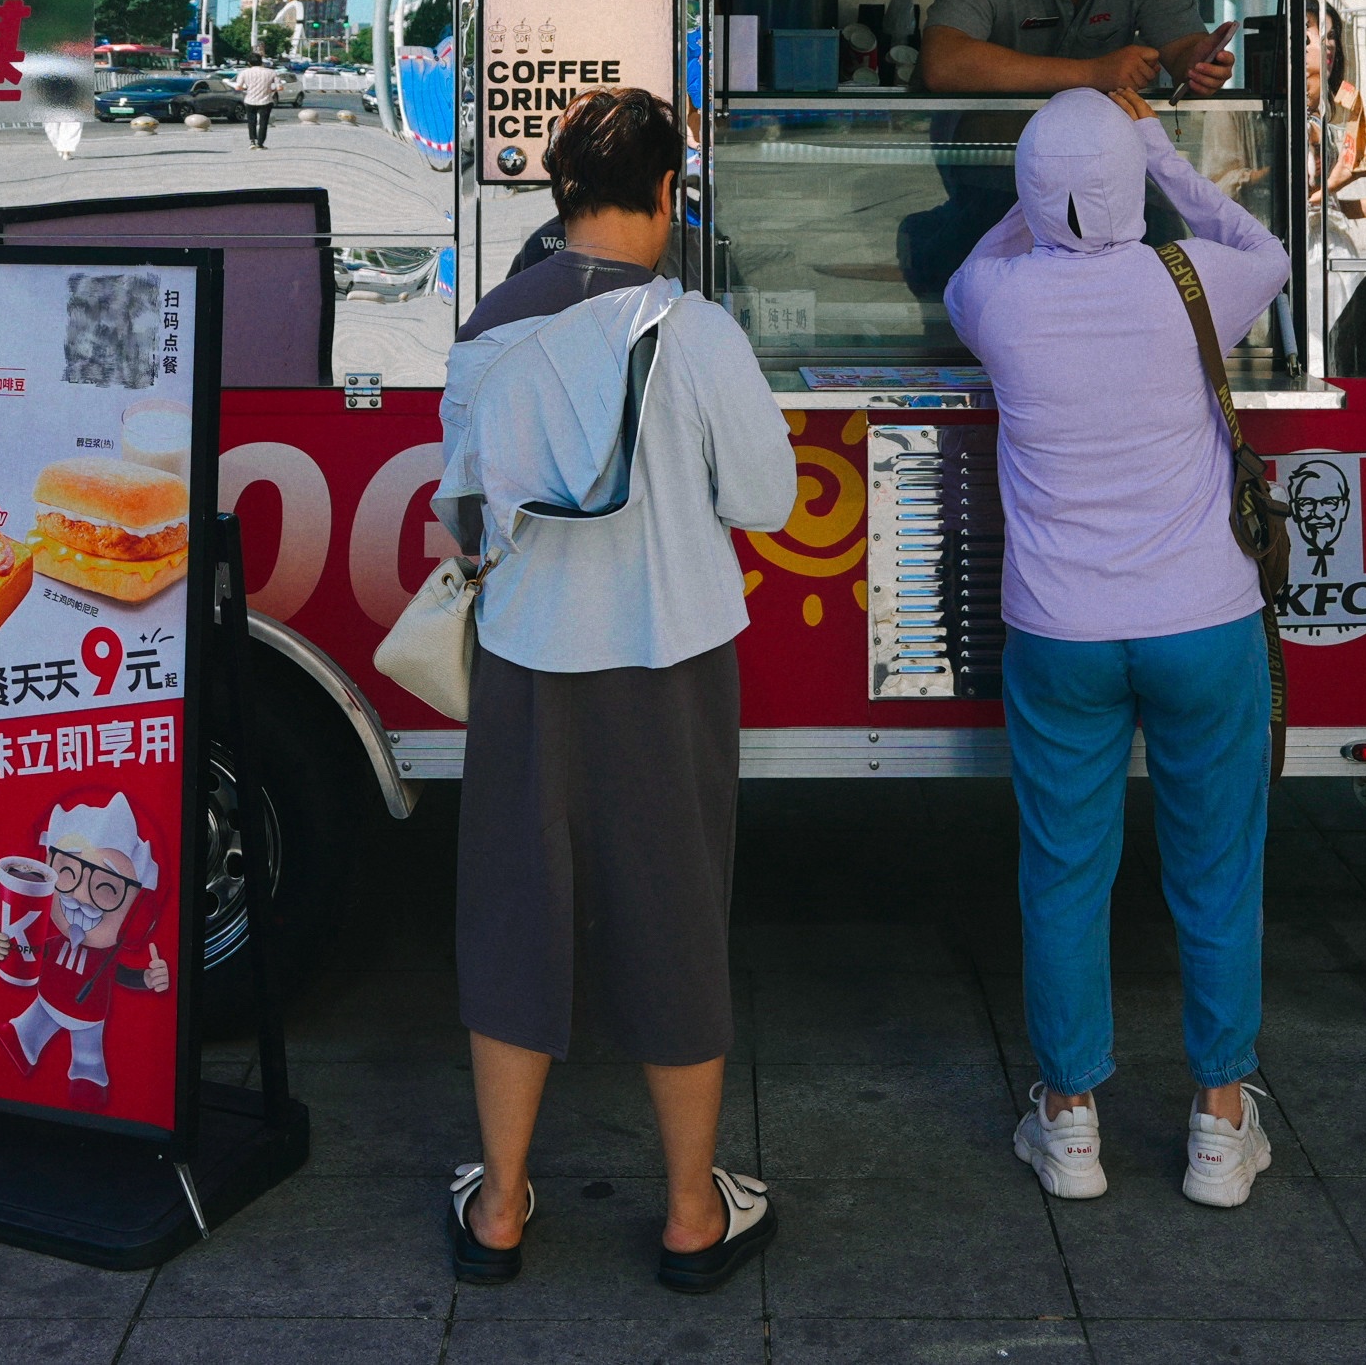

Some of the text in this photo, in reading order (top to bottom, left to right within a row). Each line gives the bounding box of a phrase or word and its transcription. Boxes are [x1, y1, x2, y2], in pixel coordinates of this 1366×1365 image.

[487, 60, 621, 84] COFFEE
[489, 115, 543, 139] ICE
[163, 289, 179, 374] 扫码点餐
[43, 588, 99, 619] 芝士鸡肉帕尼尼
[1067, 1146, 1092, 1154] U-bali
[1197, 1152, 1223, 1163] U-bali
